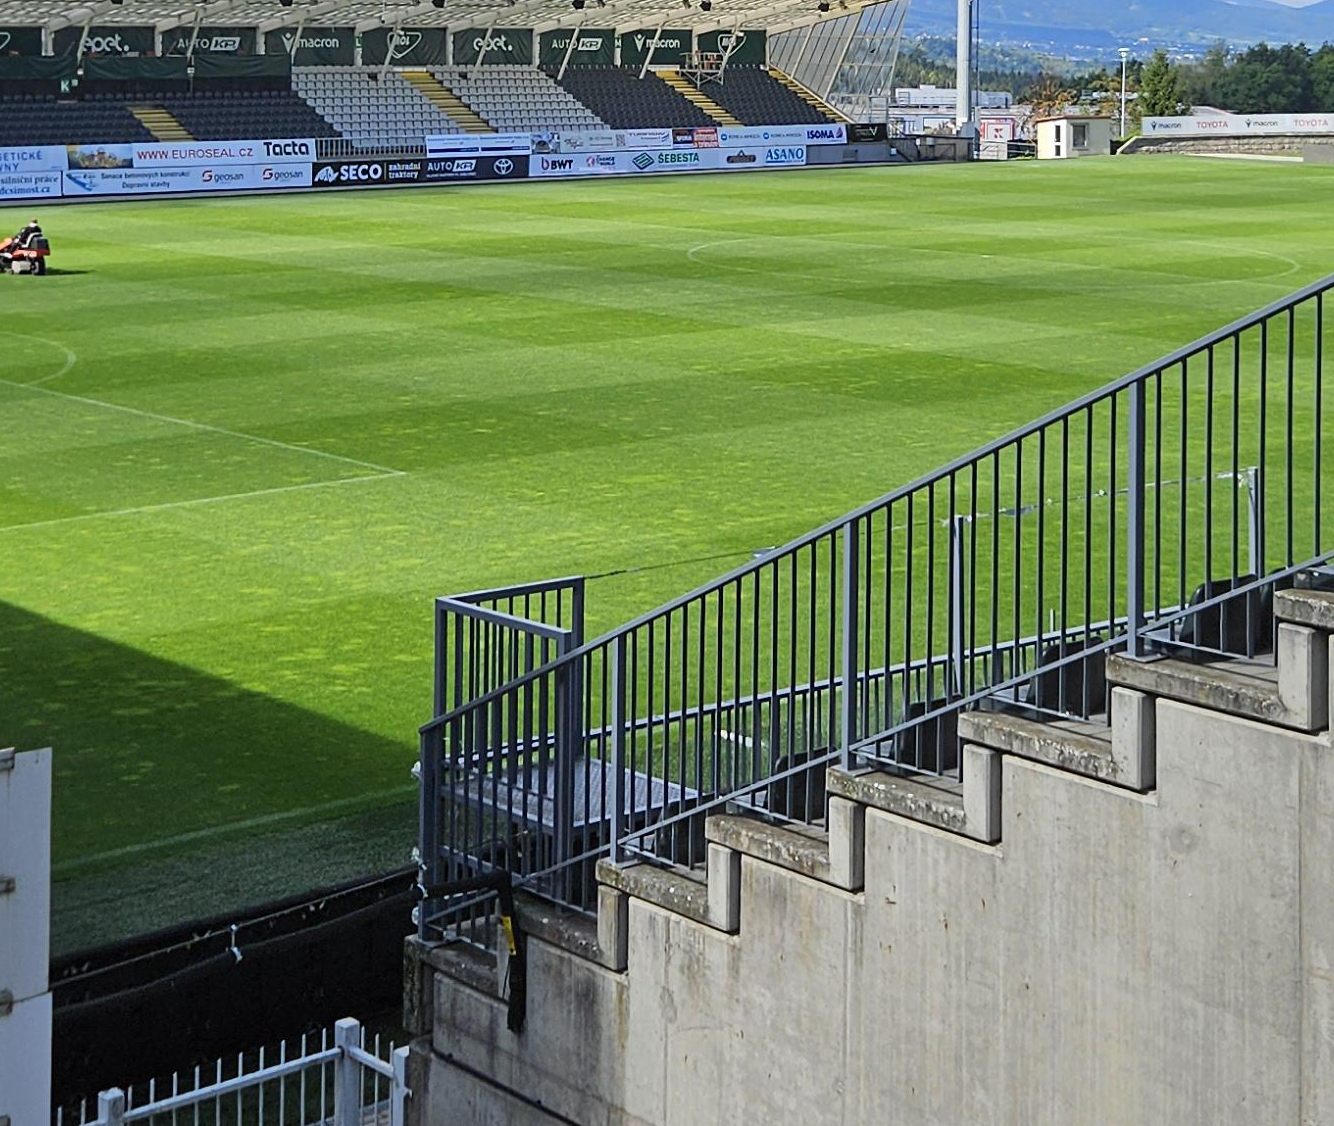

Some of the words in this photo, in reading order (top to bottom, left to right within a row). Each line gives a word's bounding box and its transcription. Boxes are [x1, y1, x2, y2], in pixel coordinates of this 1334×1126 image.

[177, 37, 210, 49] AUTO
[296, 36, 340, 48] macron
[645, 37, 680, 48] macron
[60, 79, 70, 92] K
[1157, 121, 1182, 129] macron
[1196, 120, 1228, 129] TOYOTA
[1253, 118, 1278, 127] macron
[1294, 119, 1329, 127] TOYOTA
[806, 129, 834, 139] ISOMA
[263, 141, 310, 156] Tacta
[765, 147, 804, 160] ASANO
[427, 161, 453, 171] AUTO
[550, 159, 574, 170] BWT
[214, 172, 244, 183] geosan
[274, 170, 303, 180] geosan
[340, 164, 382, 180] SECO
[34, 174, 59, 185] práce
